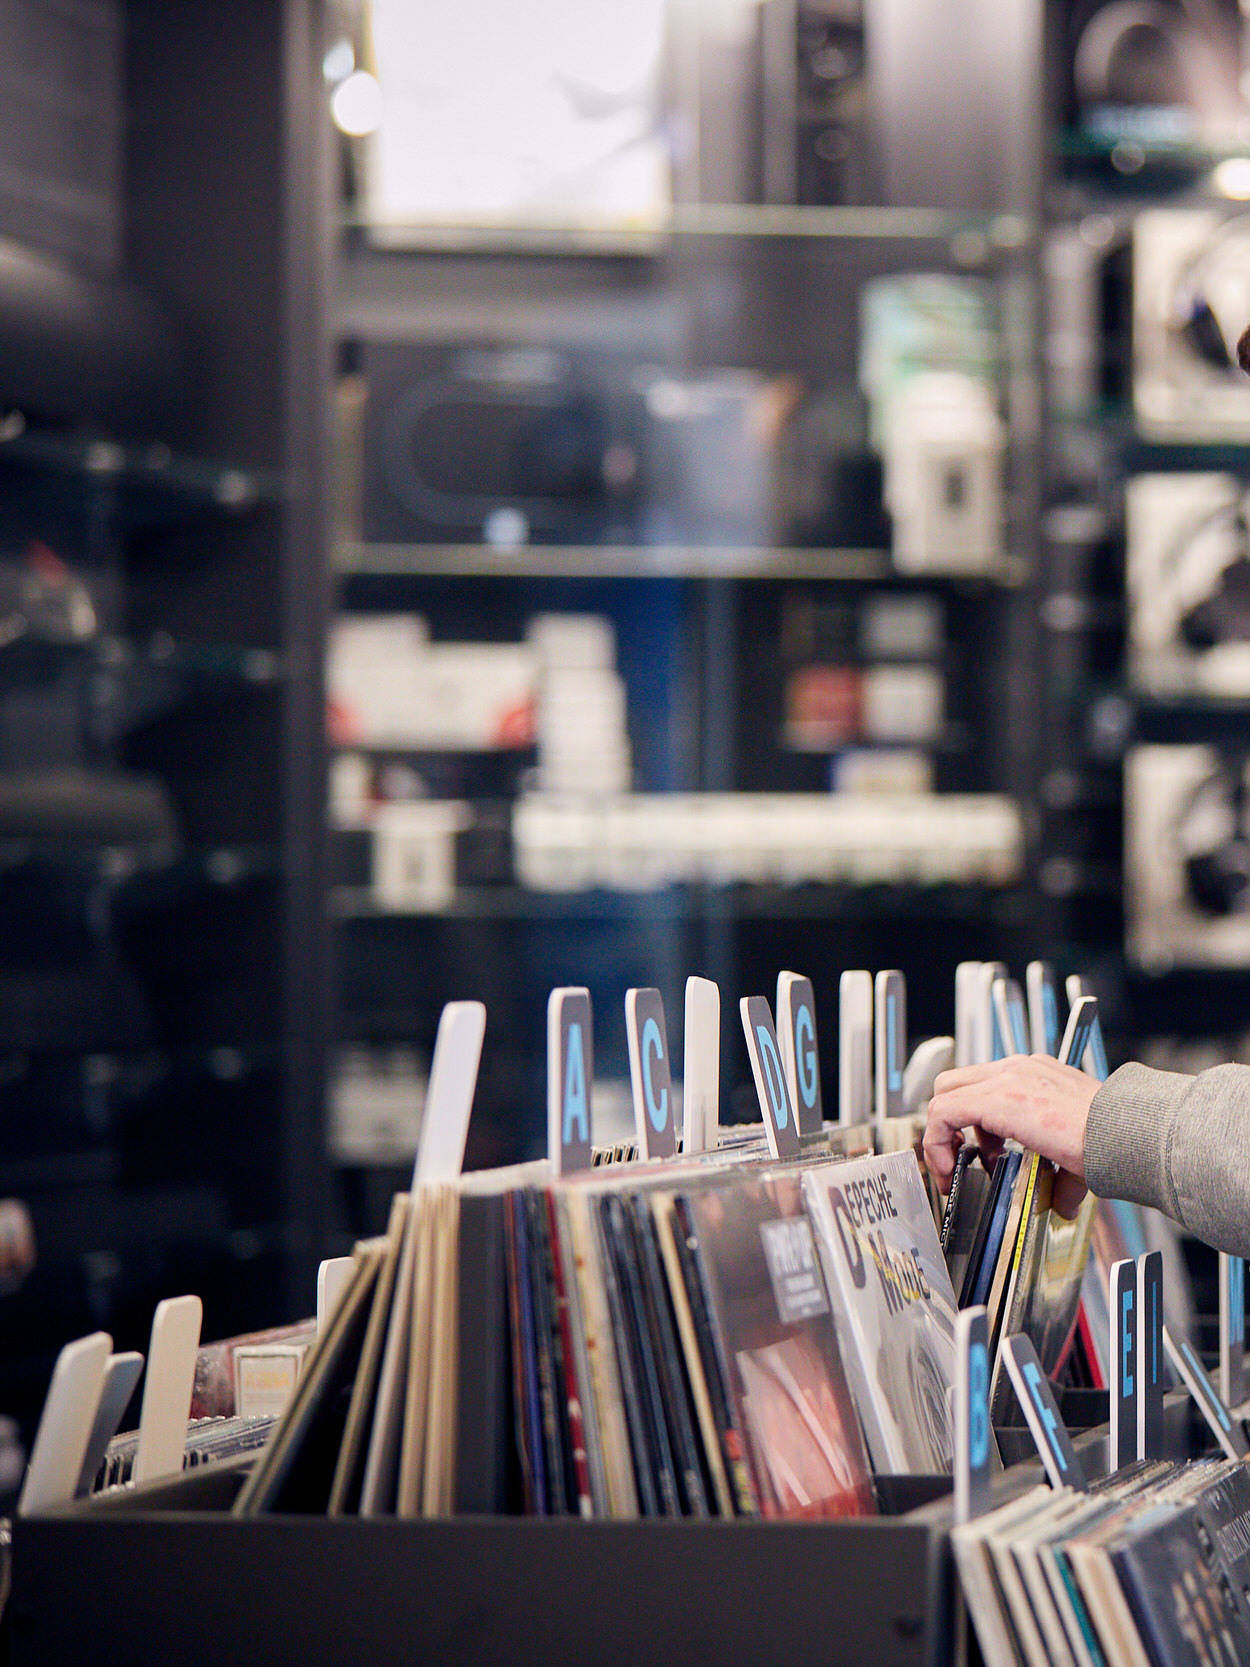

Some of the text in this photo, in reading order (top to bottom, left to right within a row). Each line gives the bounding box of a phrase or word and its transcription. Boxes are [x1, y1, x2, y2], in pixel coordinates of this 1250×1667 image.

[562, 1022, 589, 1145] A
[642, 1017, 668, 1133] C
[756, 1025, 788, 1130] D
[796, 1004, 817, 1109] G
[887, 995, 902, 1092] L
[827, 1172, 898, 1290] DEPECHE
[947, 1153, 963, 1212] GEORGE
[1122, 1289, 1133, 1398] E
[1022, 1362, 1068, 1472] F
